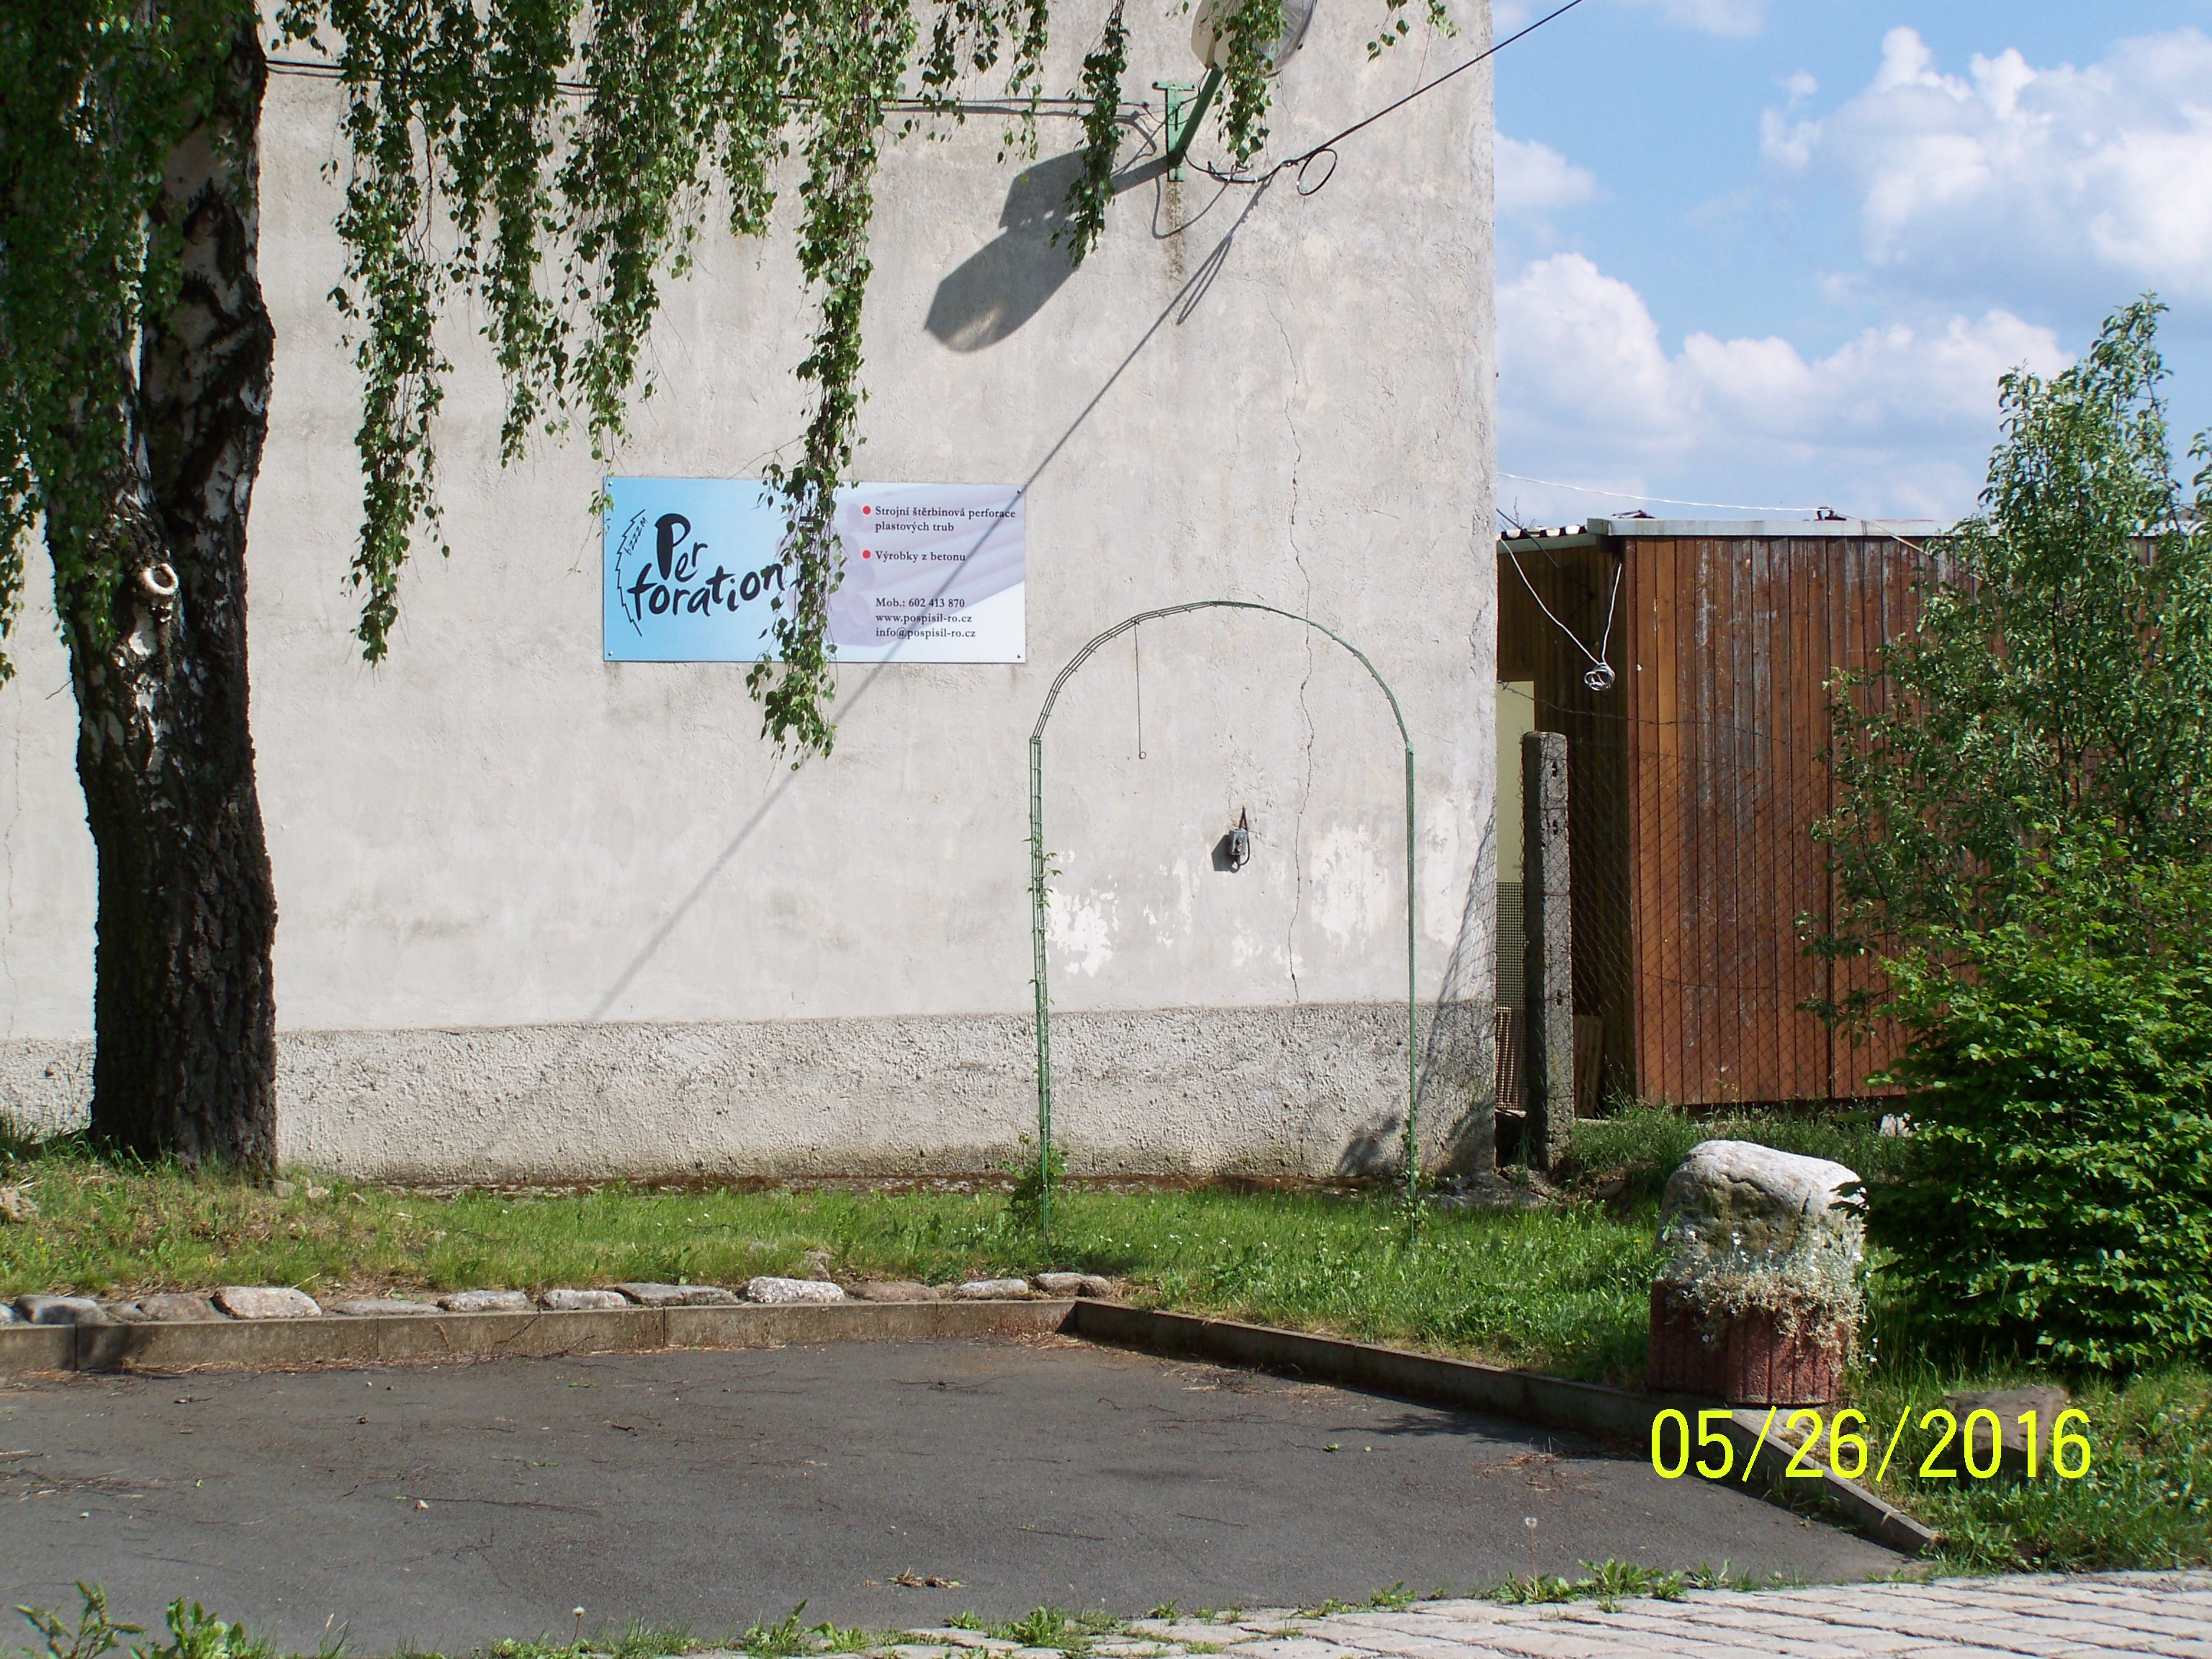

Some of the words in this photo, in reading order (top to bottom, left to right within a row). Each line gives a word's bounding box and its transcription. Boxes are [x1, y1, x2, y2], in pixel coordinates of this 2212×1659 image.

[875, 505, 909, 518] Strojní
[912, 507, 966, 517] štěrbinová
[968, 508, 1016, 519] perforace
[875, 521, 930, 533] plastových
[932, 523, 955, 531] trub
[875, 550, 919, 562] Výrobky
[930, 552, 966, 562] betonu
[876, 598, 905, 607] Mob.:
[908, 598, 925, 607] 602
[928, 599, 945, 608] 413
[948, 599, 965, 608] 870
[876, 613, 972, 624] www.pospisil-ro.cz
[876, 627, 976, 639] info@pospisil-ro.cz
